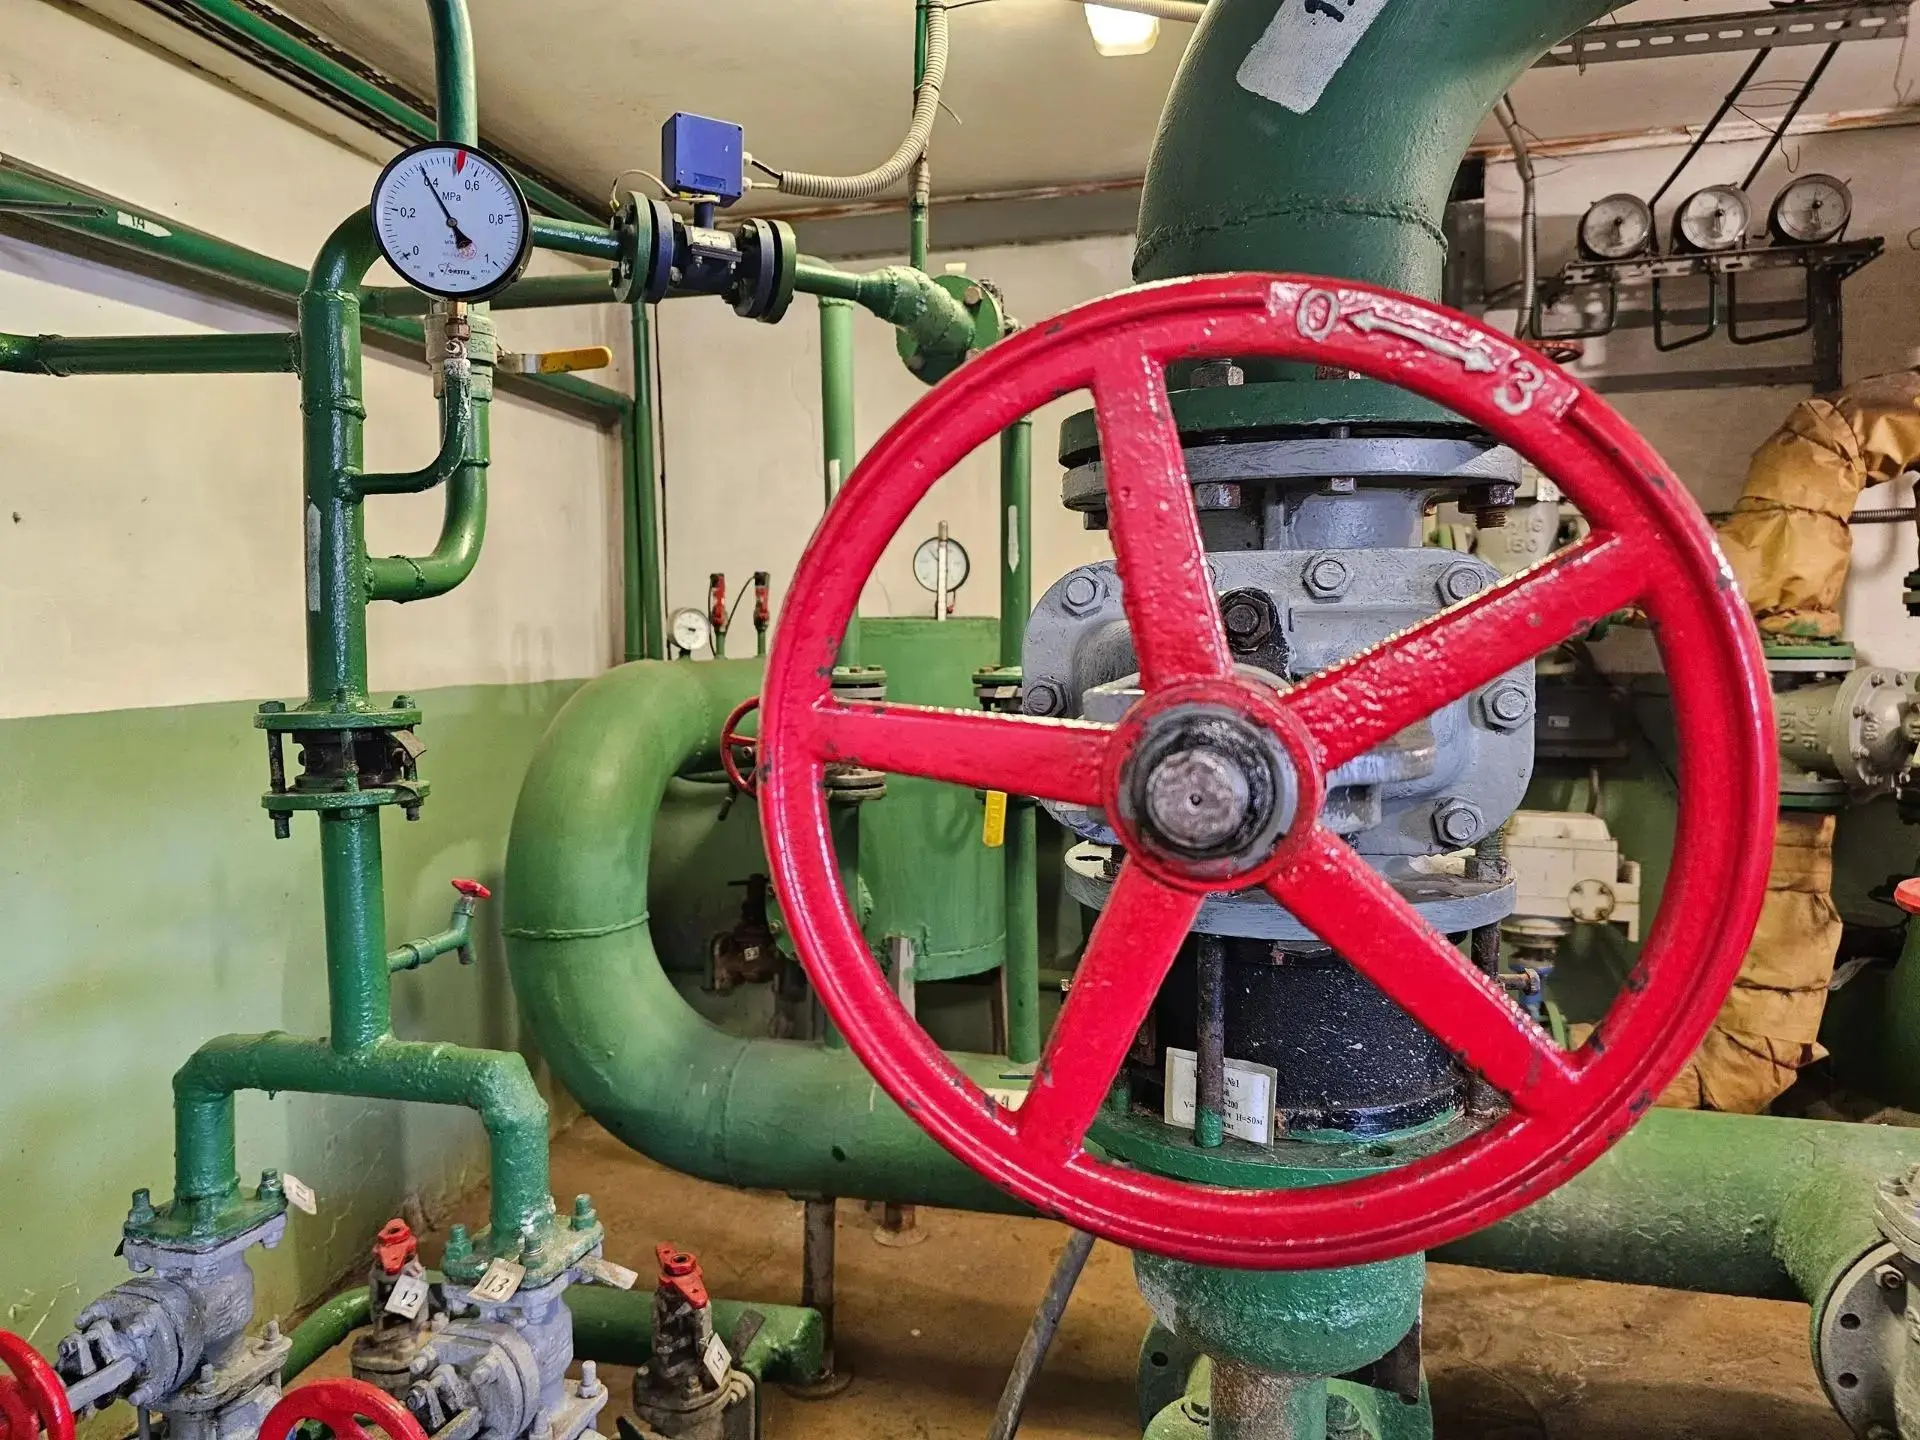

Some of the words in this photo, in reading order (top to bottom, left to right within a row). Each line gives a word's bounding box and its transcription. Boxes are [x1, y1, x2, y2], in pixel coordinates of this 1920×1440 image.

[464, 180, 480, 191] 0,6
[442, 191, 462, 202] MPa
[401, 207, 416, 219] 0,2
[488, 214, 504, 225] 0,8
[413, 246, 419, 256] 0
[484, 253, 489, 264] 1
[484, 1274, 509, 1293] 13
[401, 1290, 419, 1307] 12
